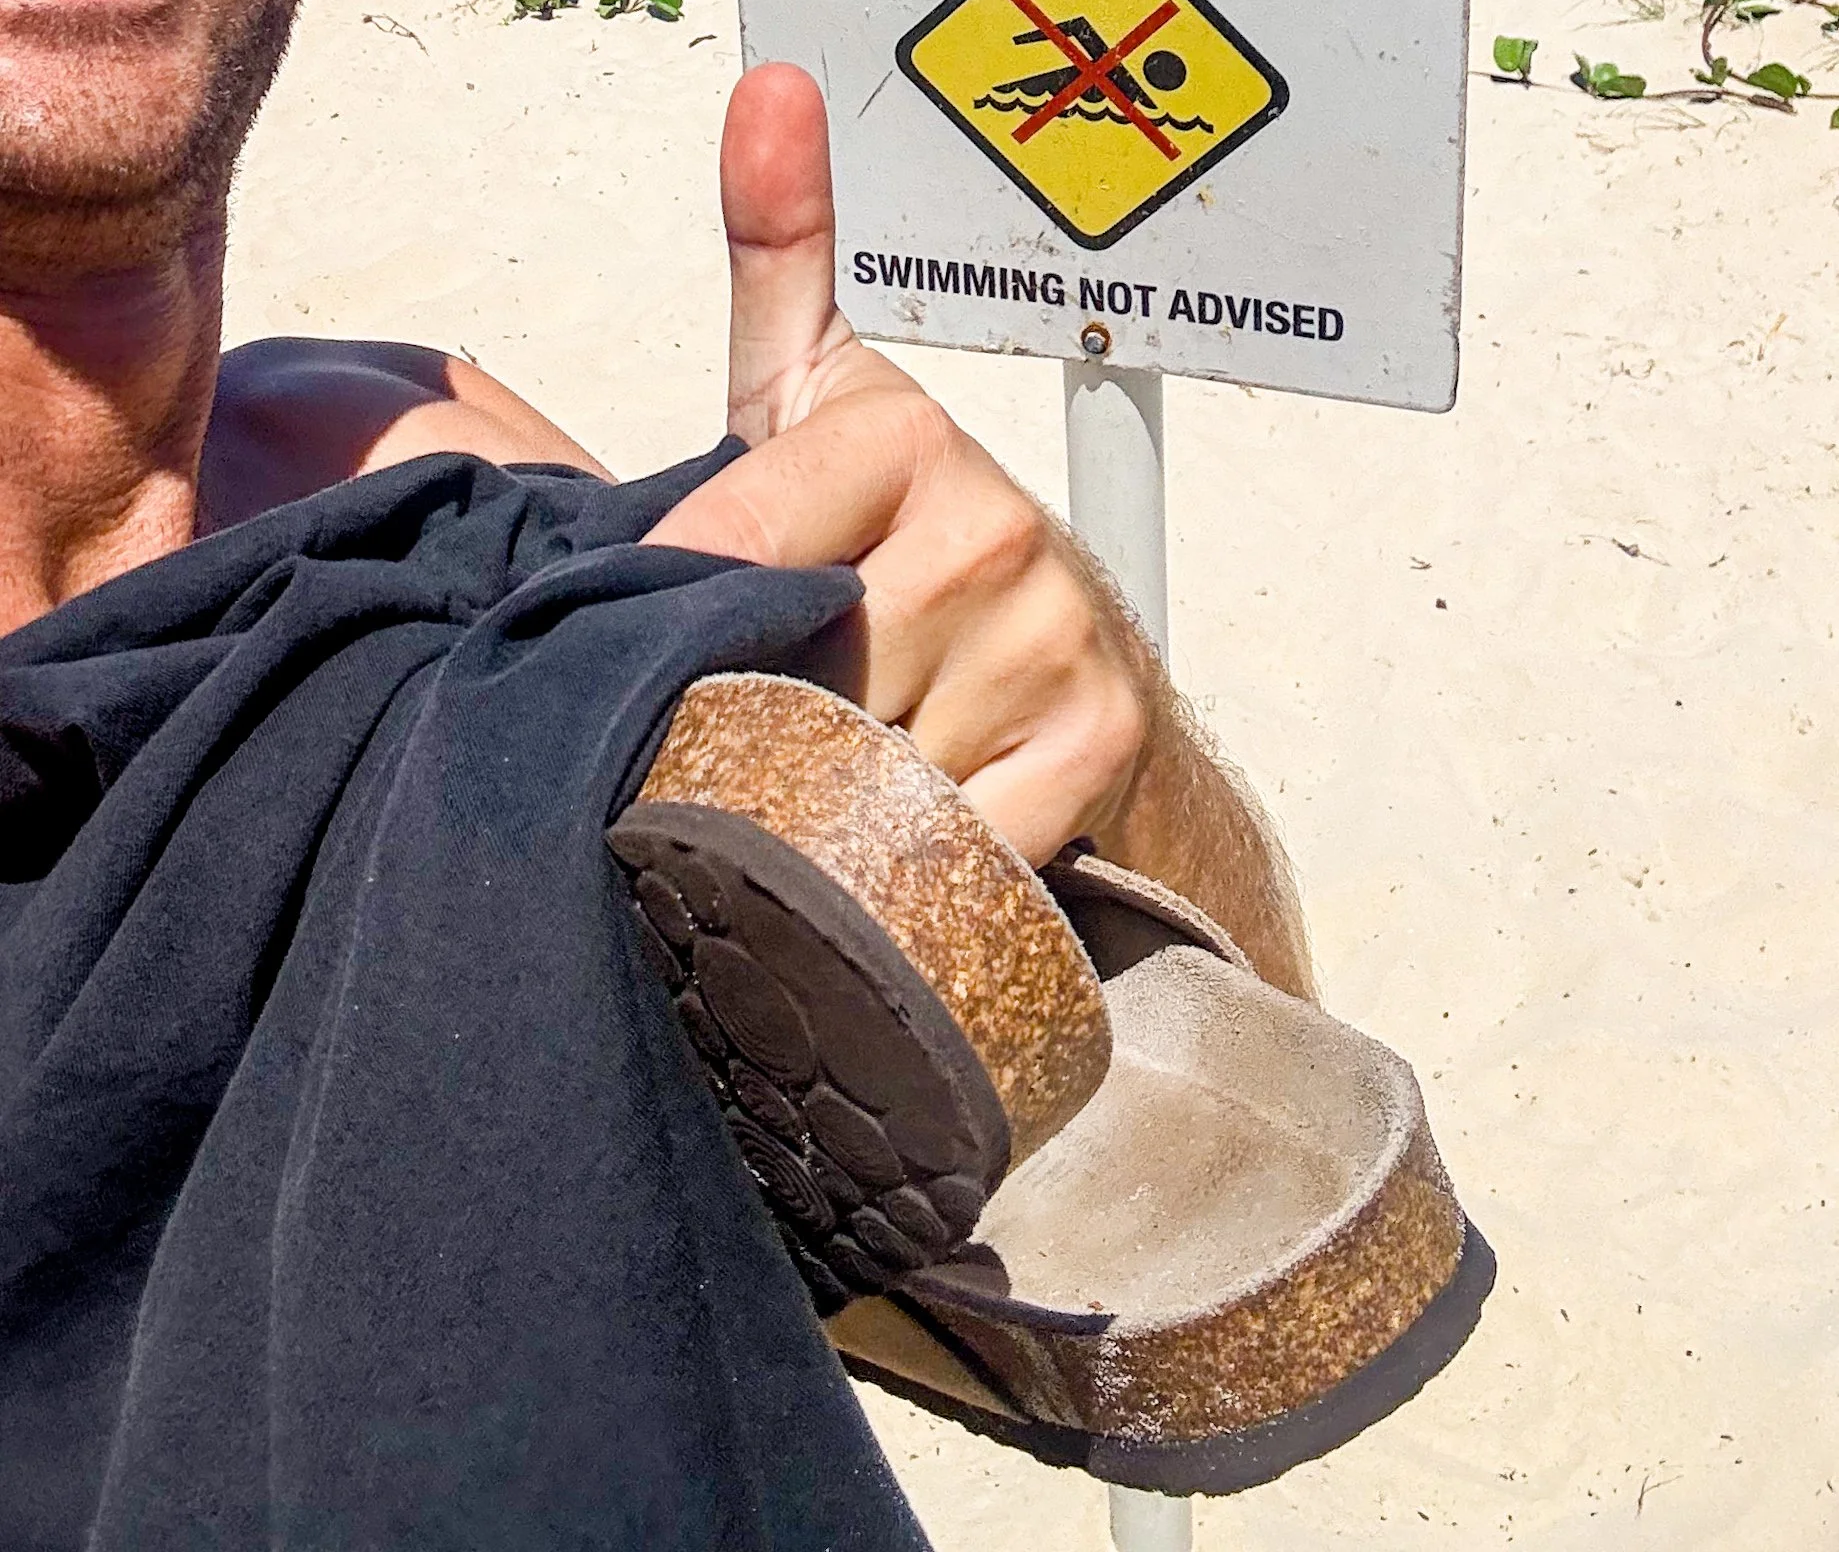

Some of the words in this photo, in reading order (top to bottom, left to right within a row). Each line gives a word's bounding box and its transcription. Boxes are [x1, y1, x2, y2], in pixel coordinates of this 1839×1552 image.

[853, 251, 1065, 307] SWIMMING
[1079, 276, 1158, 318] NOT
[1168, 289, 1344, 342] ADVISED
